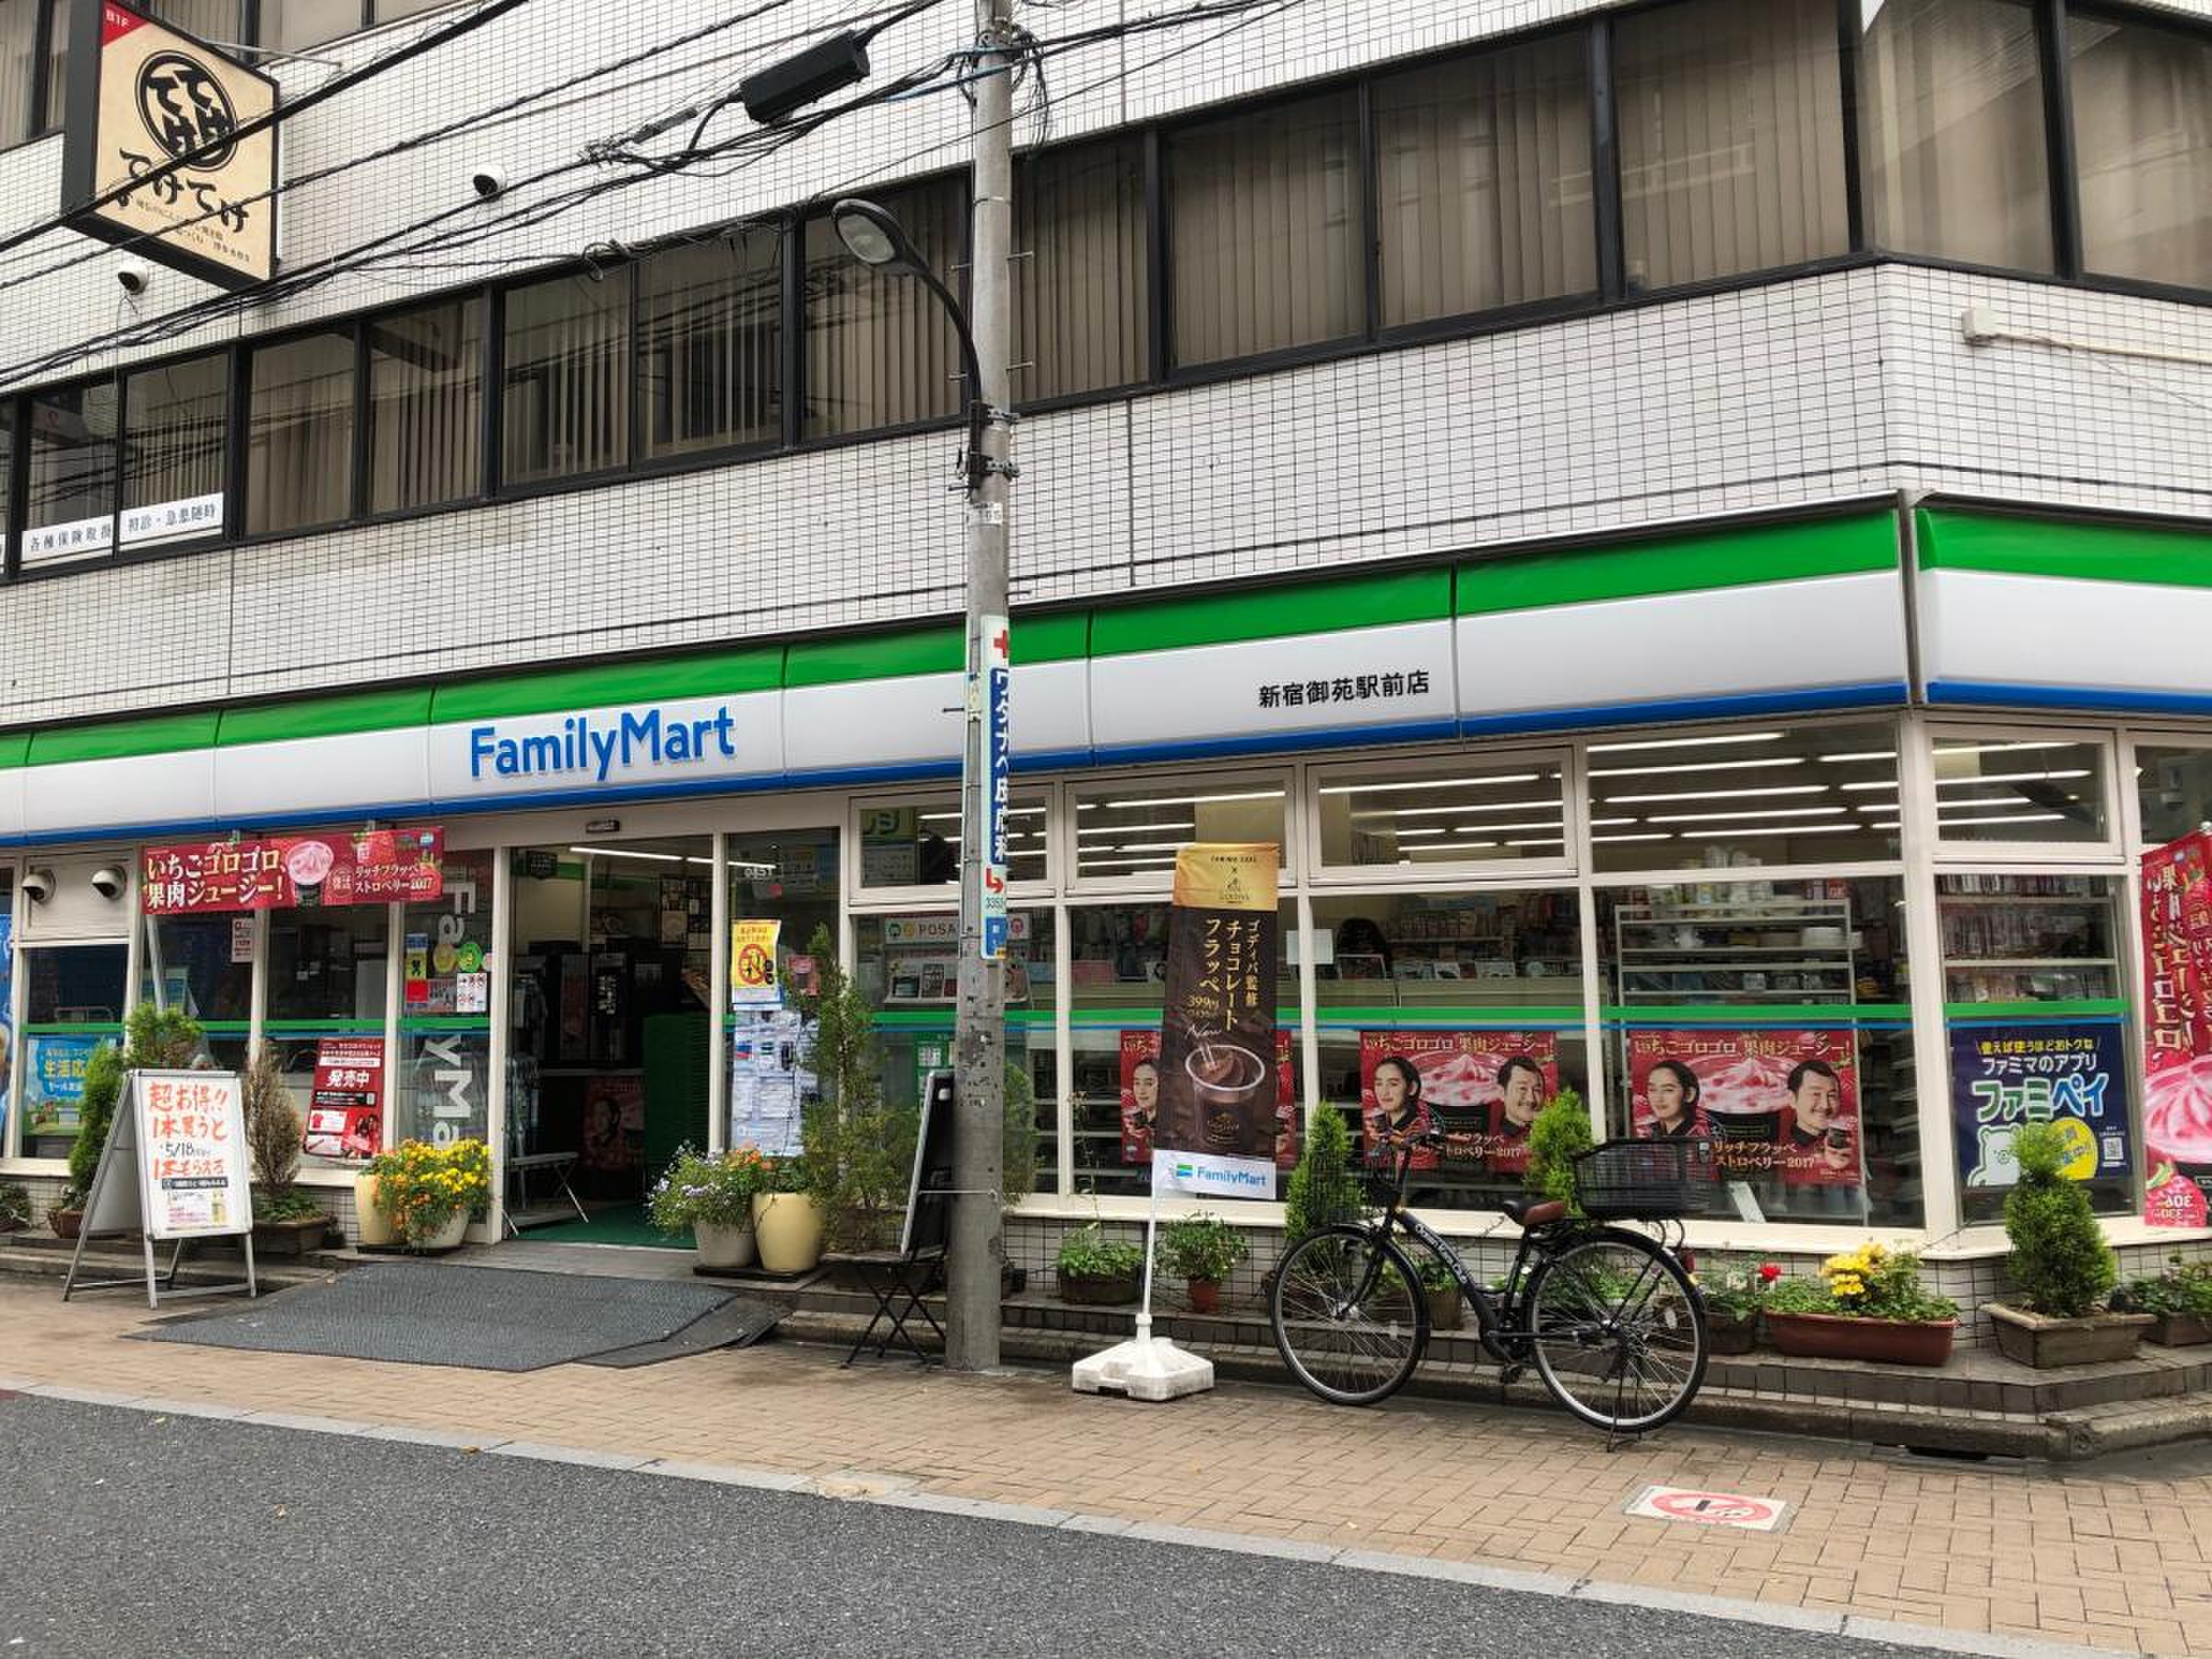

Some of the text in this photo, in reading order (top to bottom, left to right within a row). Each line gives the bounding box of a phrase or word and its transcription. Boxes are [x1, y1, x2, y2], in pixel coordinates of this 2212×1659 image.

[1258, 669, 1430, 708] 新宿御苑駅前店
[471, 706, 735, 782] FamilyMart
[1199, 918, 1221, 993] フラッペ
[1225, 920, 1242, 1030] チョコレート
[325, 1069, 370, 1088] 発売中
[1983, 1053, 2098, 1076] ファミマのアプリ
[1971, 1073, 2110, 1123] ファミペイ
[1197, 1167, 1267, 1187] FamilyMart
